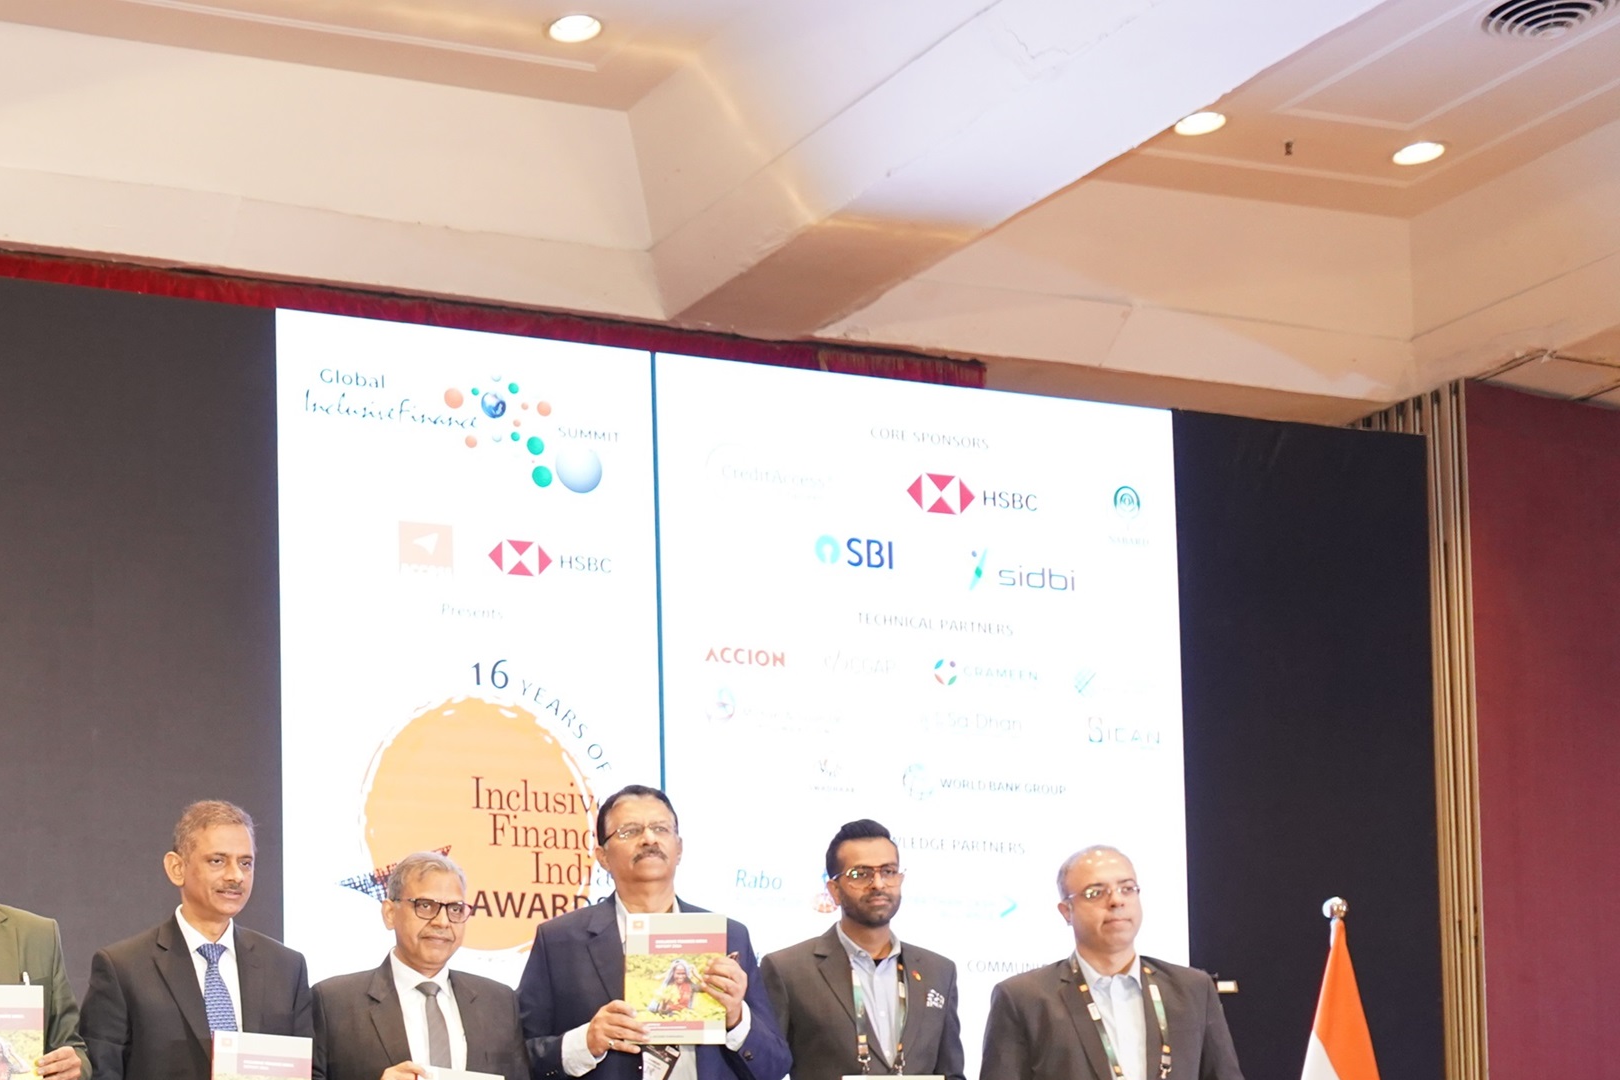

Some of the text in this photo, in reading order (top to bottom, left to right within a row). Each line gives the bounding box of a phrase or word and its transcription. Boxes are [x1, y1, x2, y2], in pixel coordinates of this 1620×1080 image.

[319, 367, 385, 389] Global
[558, 426, 620, 443] SUMMIT
[870, 427, 990, 450] CORE SPONSORS
[982, 489, 1039, 512] HSBC
[560, 555, 612, 574] HSBC
[846, 537, 895, 570] SBI
[998, 564, 1076, 591] sidbi
[441, 602, 504, 620] Presents
[858, 611, 1014, 637] TECHNICAL PARTNERS
[705, 646, 786, 668] ACCION
[471, 658, 613, 773] 16 YEARS OF
[471, 776, 599, 816] Inclusiv
[940, 777, 1067, 796] WORLD BANK GROUP
[488, 812, 595, 851] Financ
[952, 838, 1026, 855] PARTNERS
[734, 868, 783, 891] Rabo
